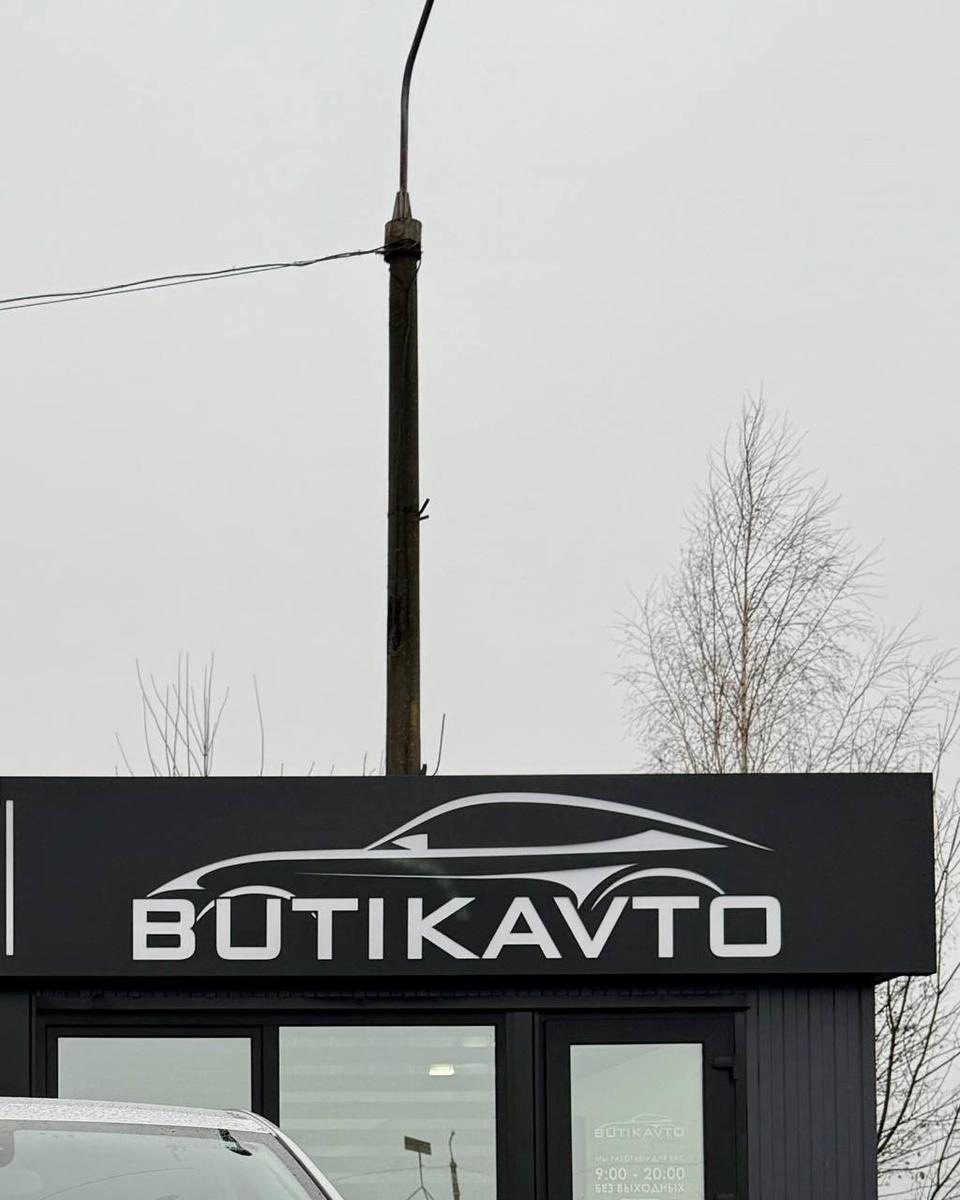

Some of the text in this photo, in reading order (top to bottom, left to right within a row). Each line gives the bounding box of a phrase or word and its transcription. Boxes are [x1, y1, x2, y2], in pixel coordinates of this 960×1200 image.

[132, 895, 782, 961] BUTIKAVTO
[594, 1127, 684, 1138] BUTIKAVTO
[595, 1167, 627, 1180] 9:00
[644, 1167, 685, 1180] 20:00
[595, 1183, 685, 1193] БЕЗ ВЫХОДНЫХ
